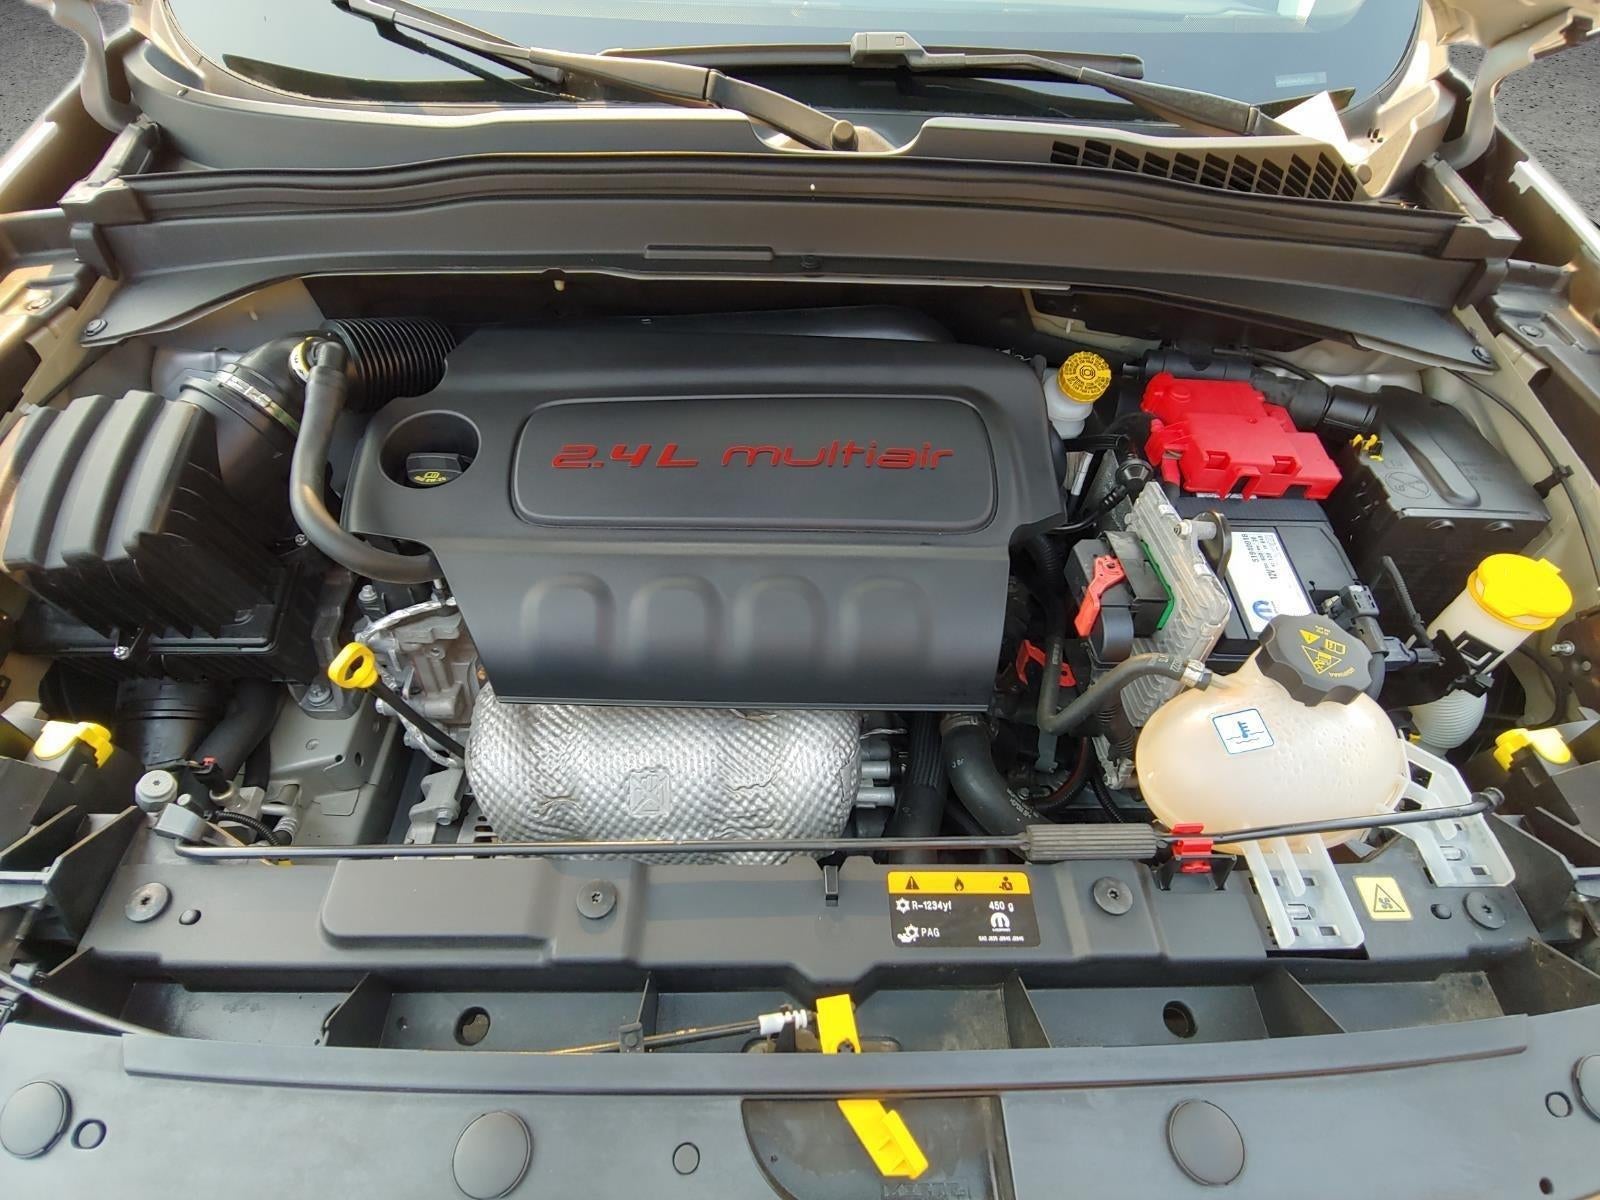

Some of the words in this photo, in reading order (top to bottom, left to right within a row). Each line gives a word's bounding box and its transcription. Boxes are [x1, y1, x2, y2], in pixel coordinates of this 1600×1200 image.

[721, 440, 954, 469] multiair
[912, 900, 952, 912] R-1234yf
[989, 901, 1005, 910] 450
[1007, 903, 1014, 912] g
[921, 927, 940, 937] PAG
